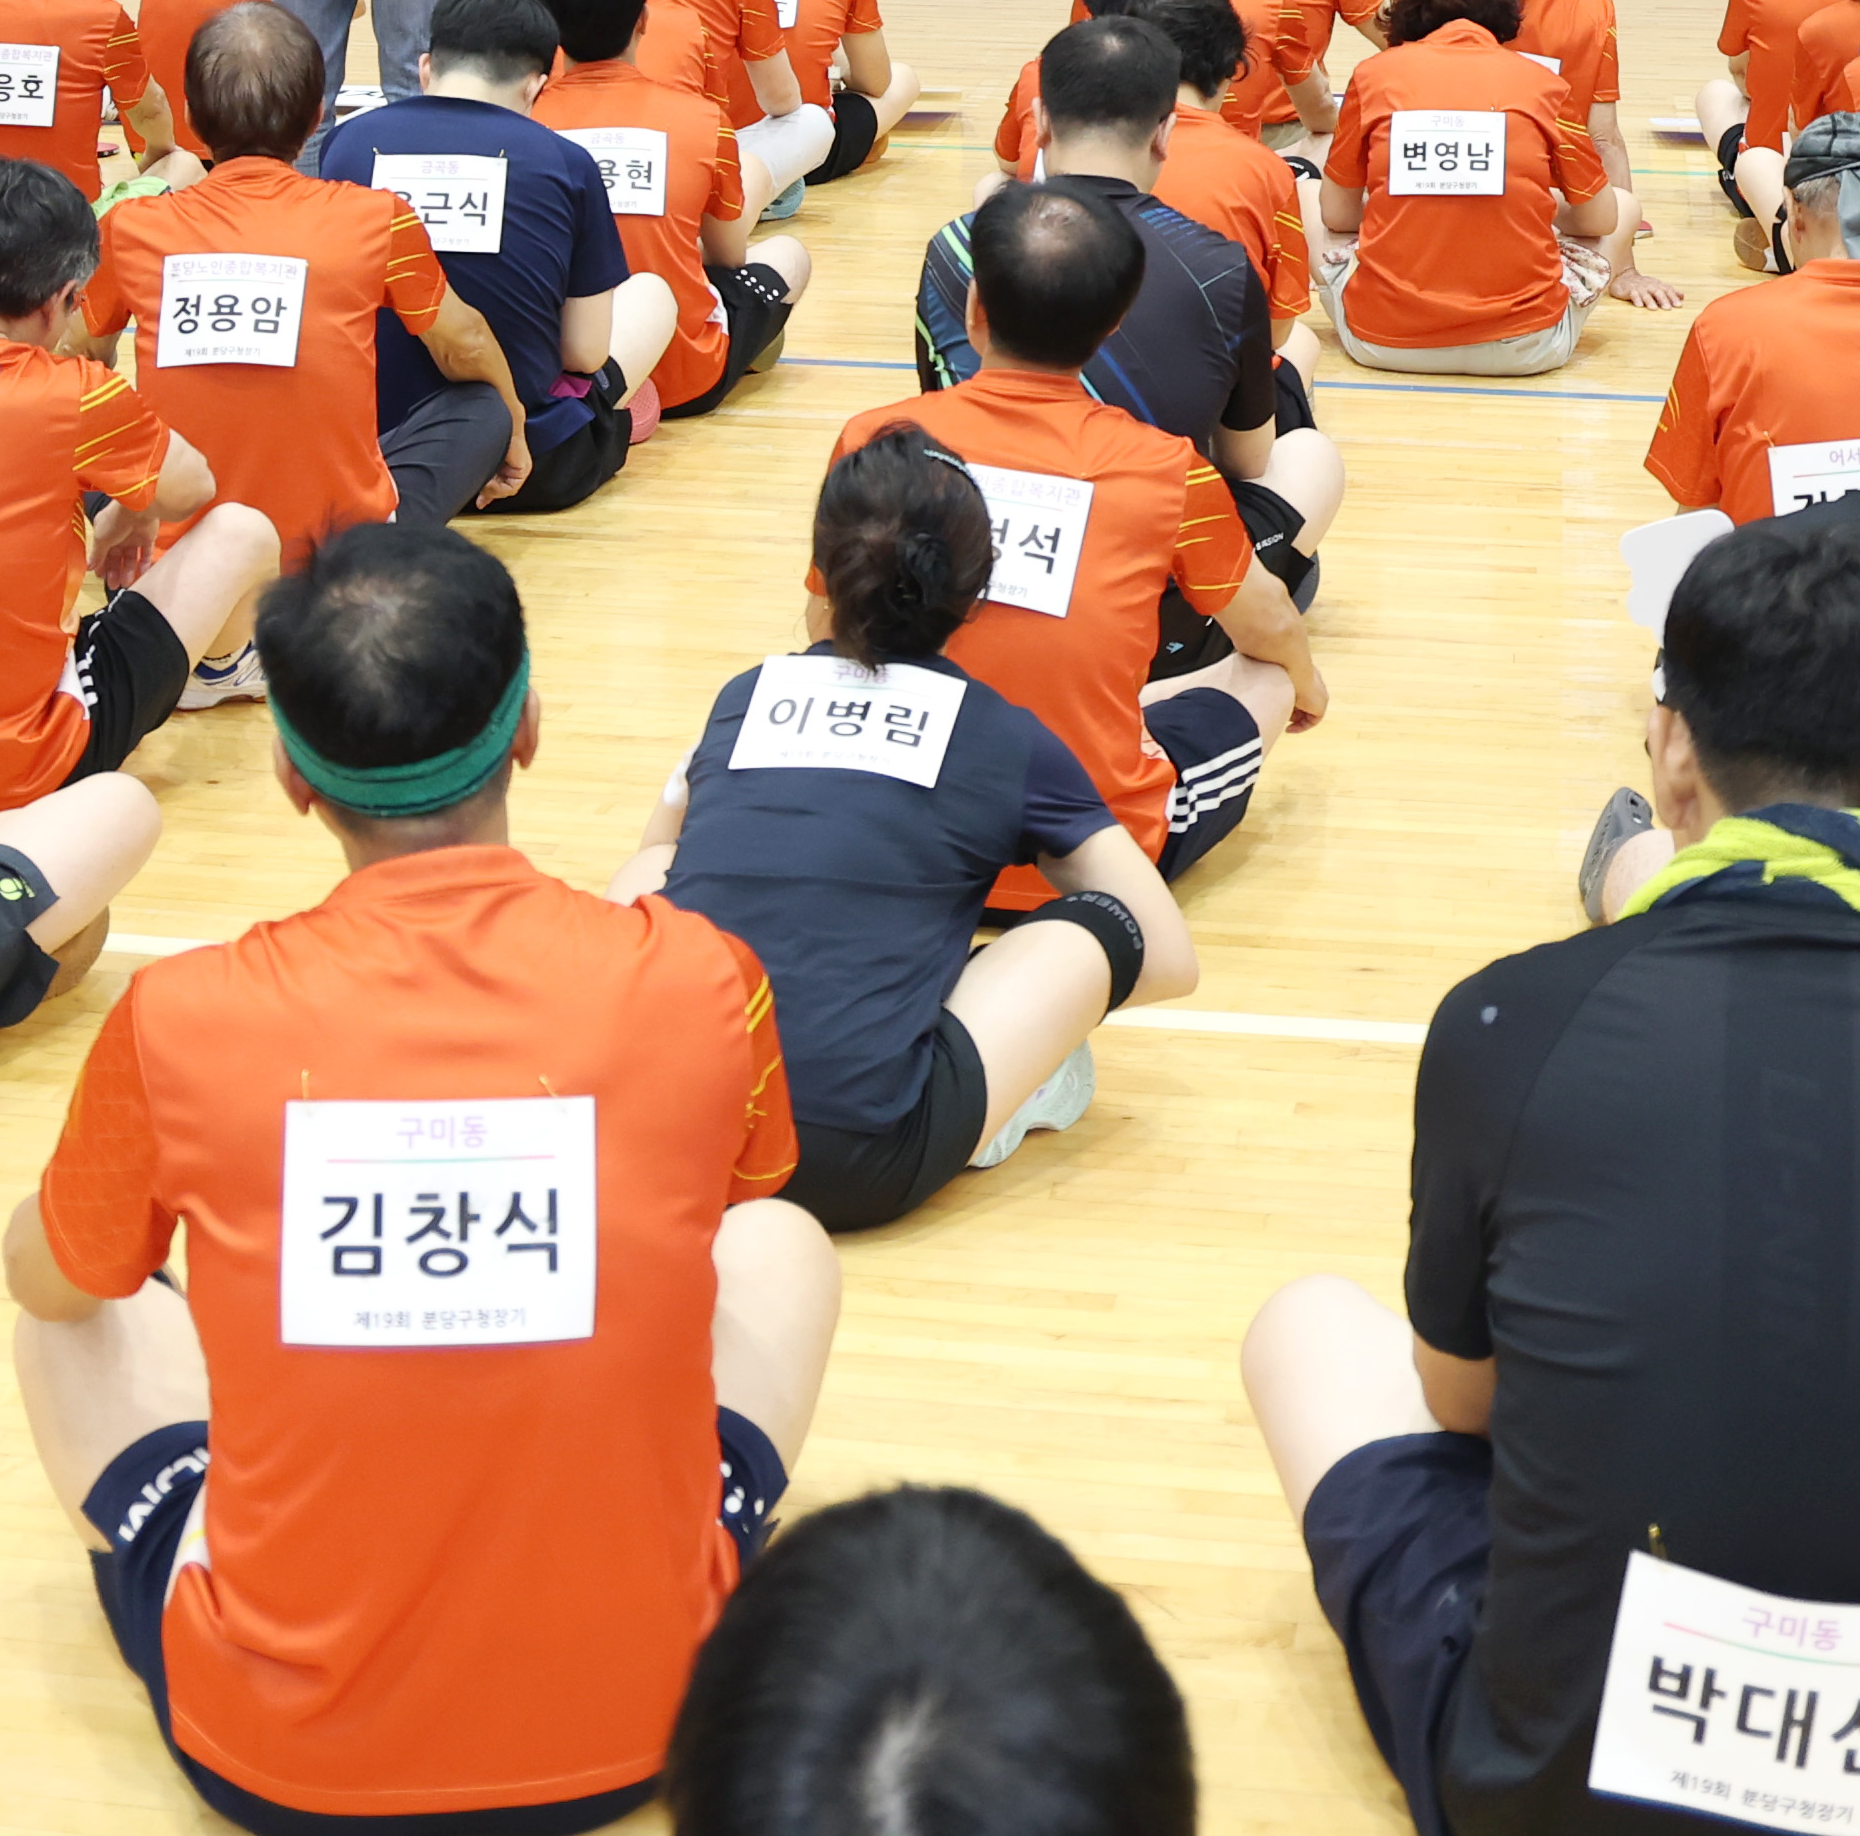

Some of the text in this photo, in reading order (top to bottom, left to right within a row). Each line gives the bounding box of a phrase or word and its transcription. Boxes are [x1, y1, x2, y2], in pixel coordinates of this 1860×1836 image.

[1430, 114, 1465, 128] 구미동
[590, 132, 624, 145] 금곡동
[420, 159, 459, 175] 금곡동
[1403, 141, 1494, 171] 변영남
[598, 158, 652, 190] 용현
[171, 257, 299, 280] 분당노인종합복지관
[172, 292, 288, 334] 정용암
[211, 345, 262, 357] 분당구청장기
[768, 696, 931, 747] 이병림
[395, 1114, 487, 1151] 구미동
[318, 1186, 561, 1280] 김창식
[353, 1305, 527, 1332] 제19회 분당구청장기
[1742, 1606, 1845, 1651] 구미동
[1670, 1768, 1856, 1828] 제19회 분당구청장기
